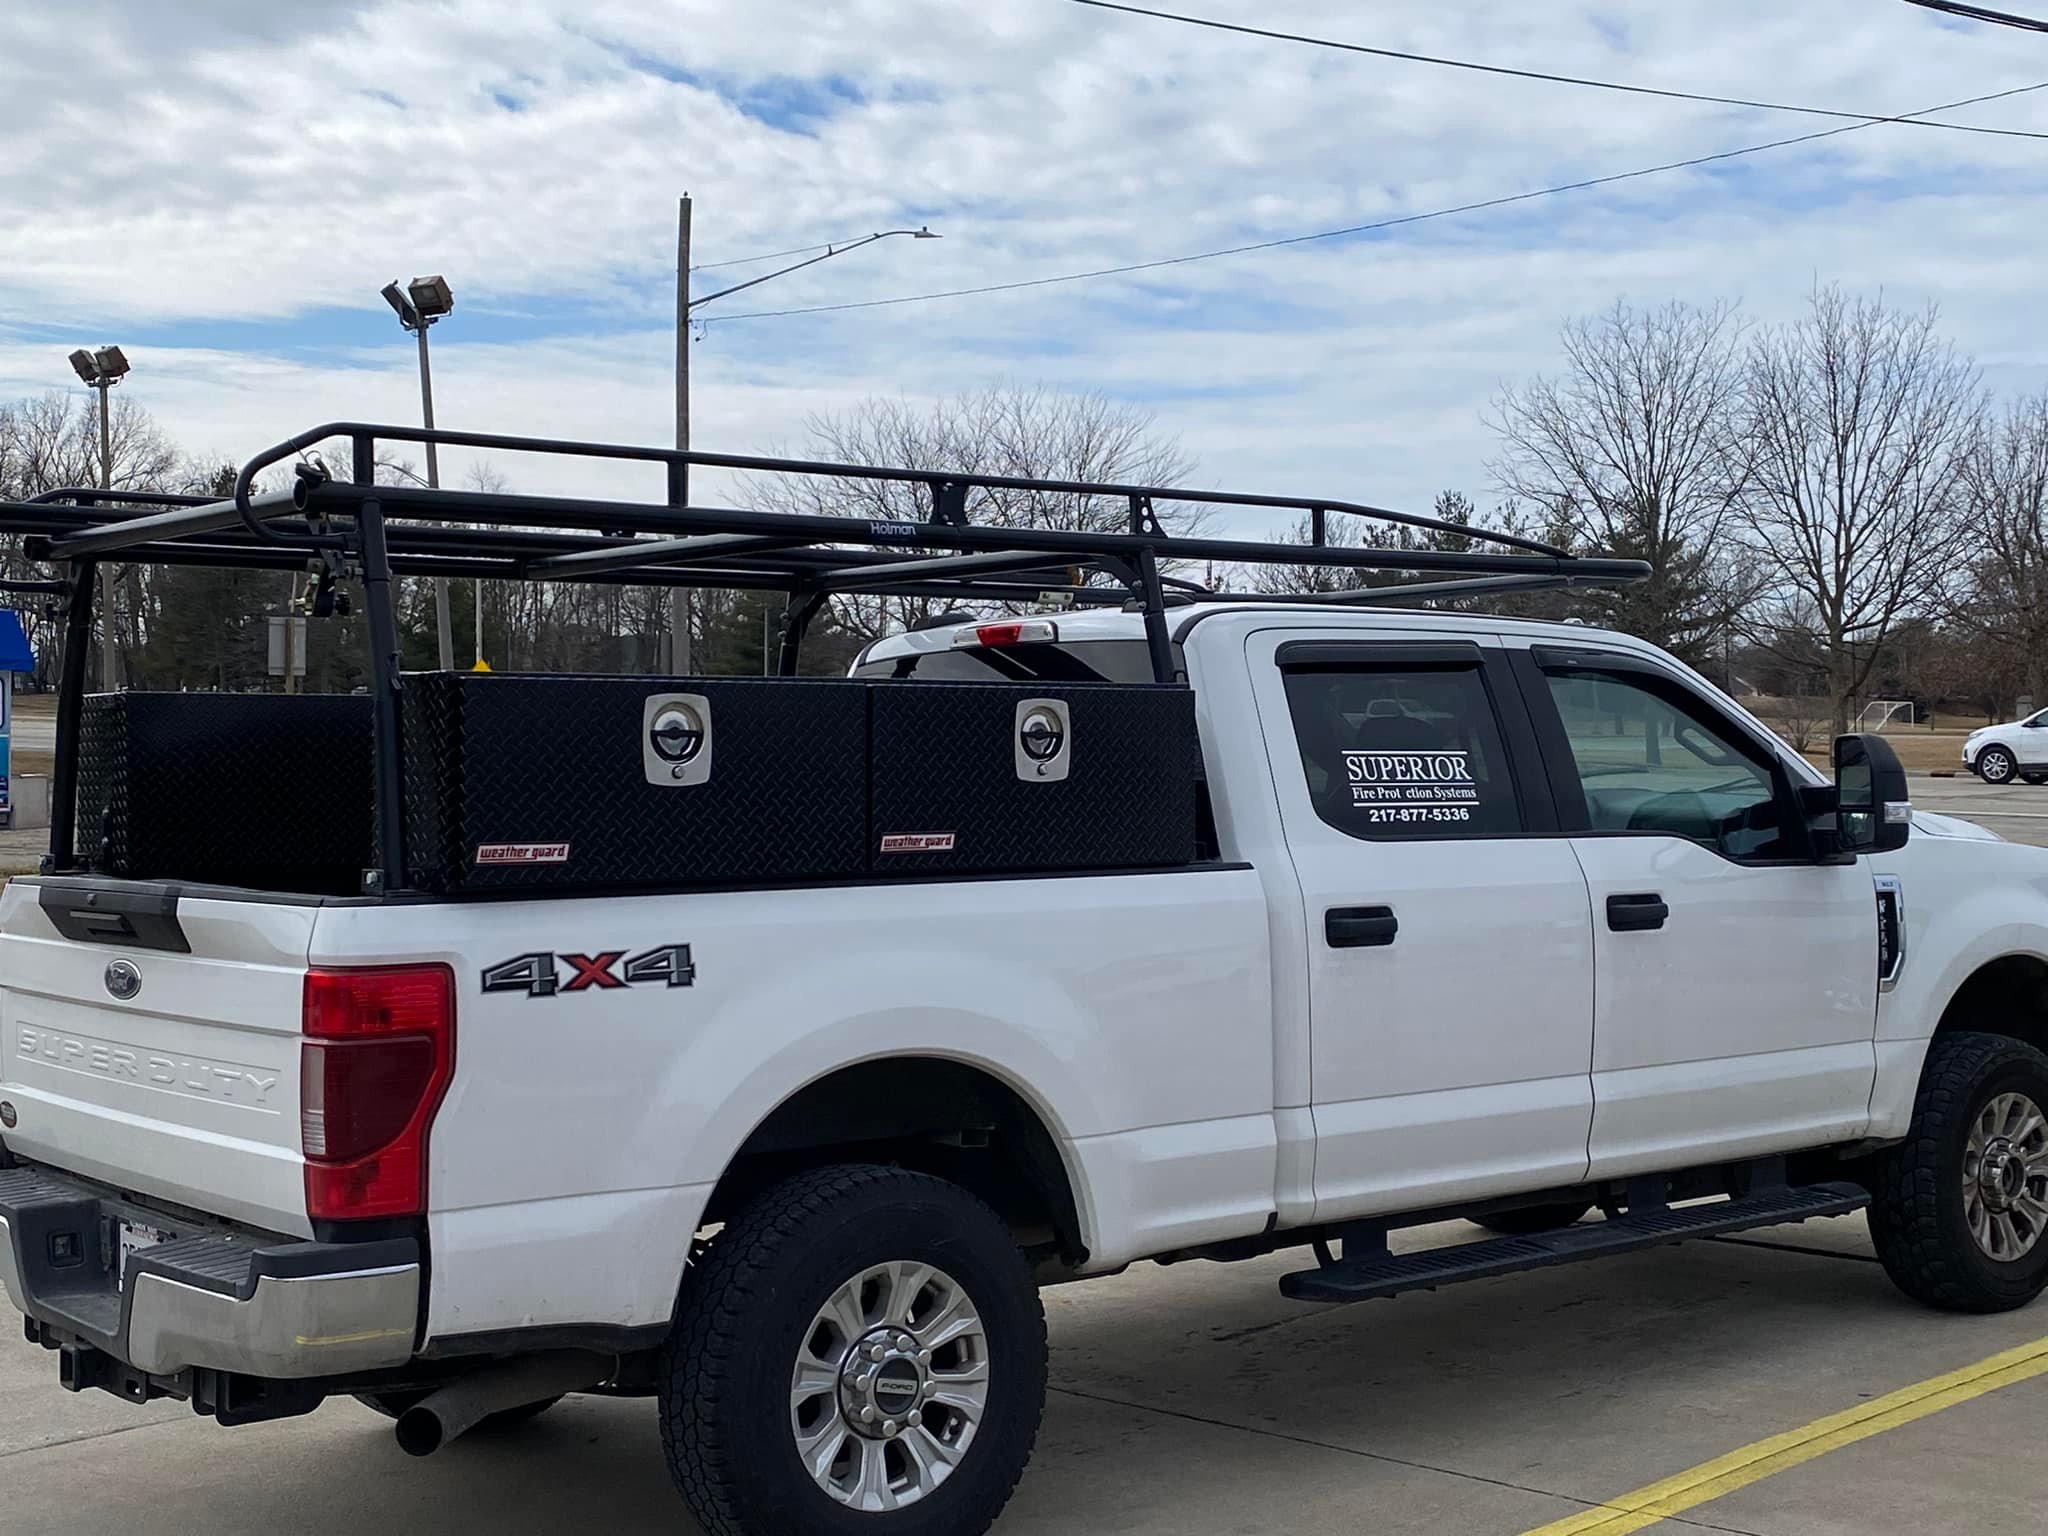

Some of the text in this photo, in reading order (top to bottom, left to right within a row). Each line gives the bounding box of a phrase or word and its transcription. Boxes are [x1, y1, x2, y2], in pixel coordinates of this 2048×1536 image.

[871, 522, 916, 535] Holman
[1346, 756, 1472, 780] SUPERIOR
[1352, 786, 1477, 800] Fire Protction Systems
[1369, 808, 1469, 822] 217-877-5336
[883, 835, 952, 848] weather guard
[480, 845, 566, 860] weather guard
[20, 1029, 277, 1102] SUPER DUTY
